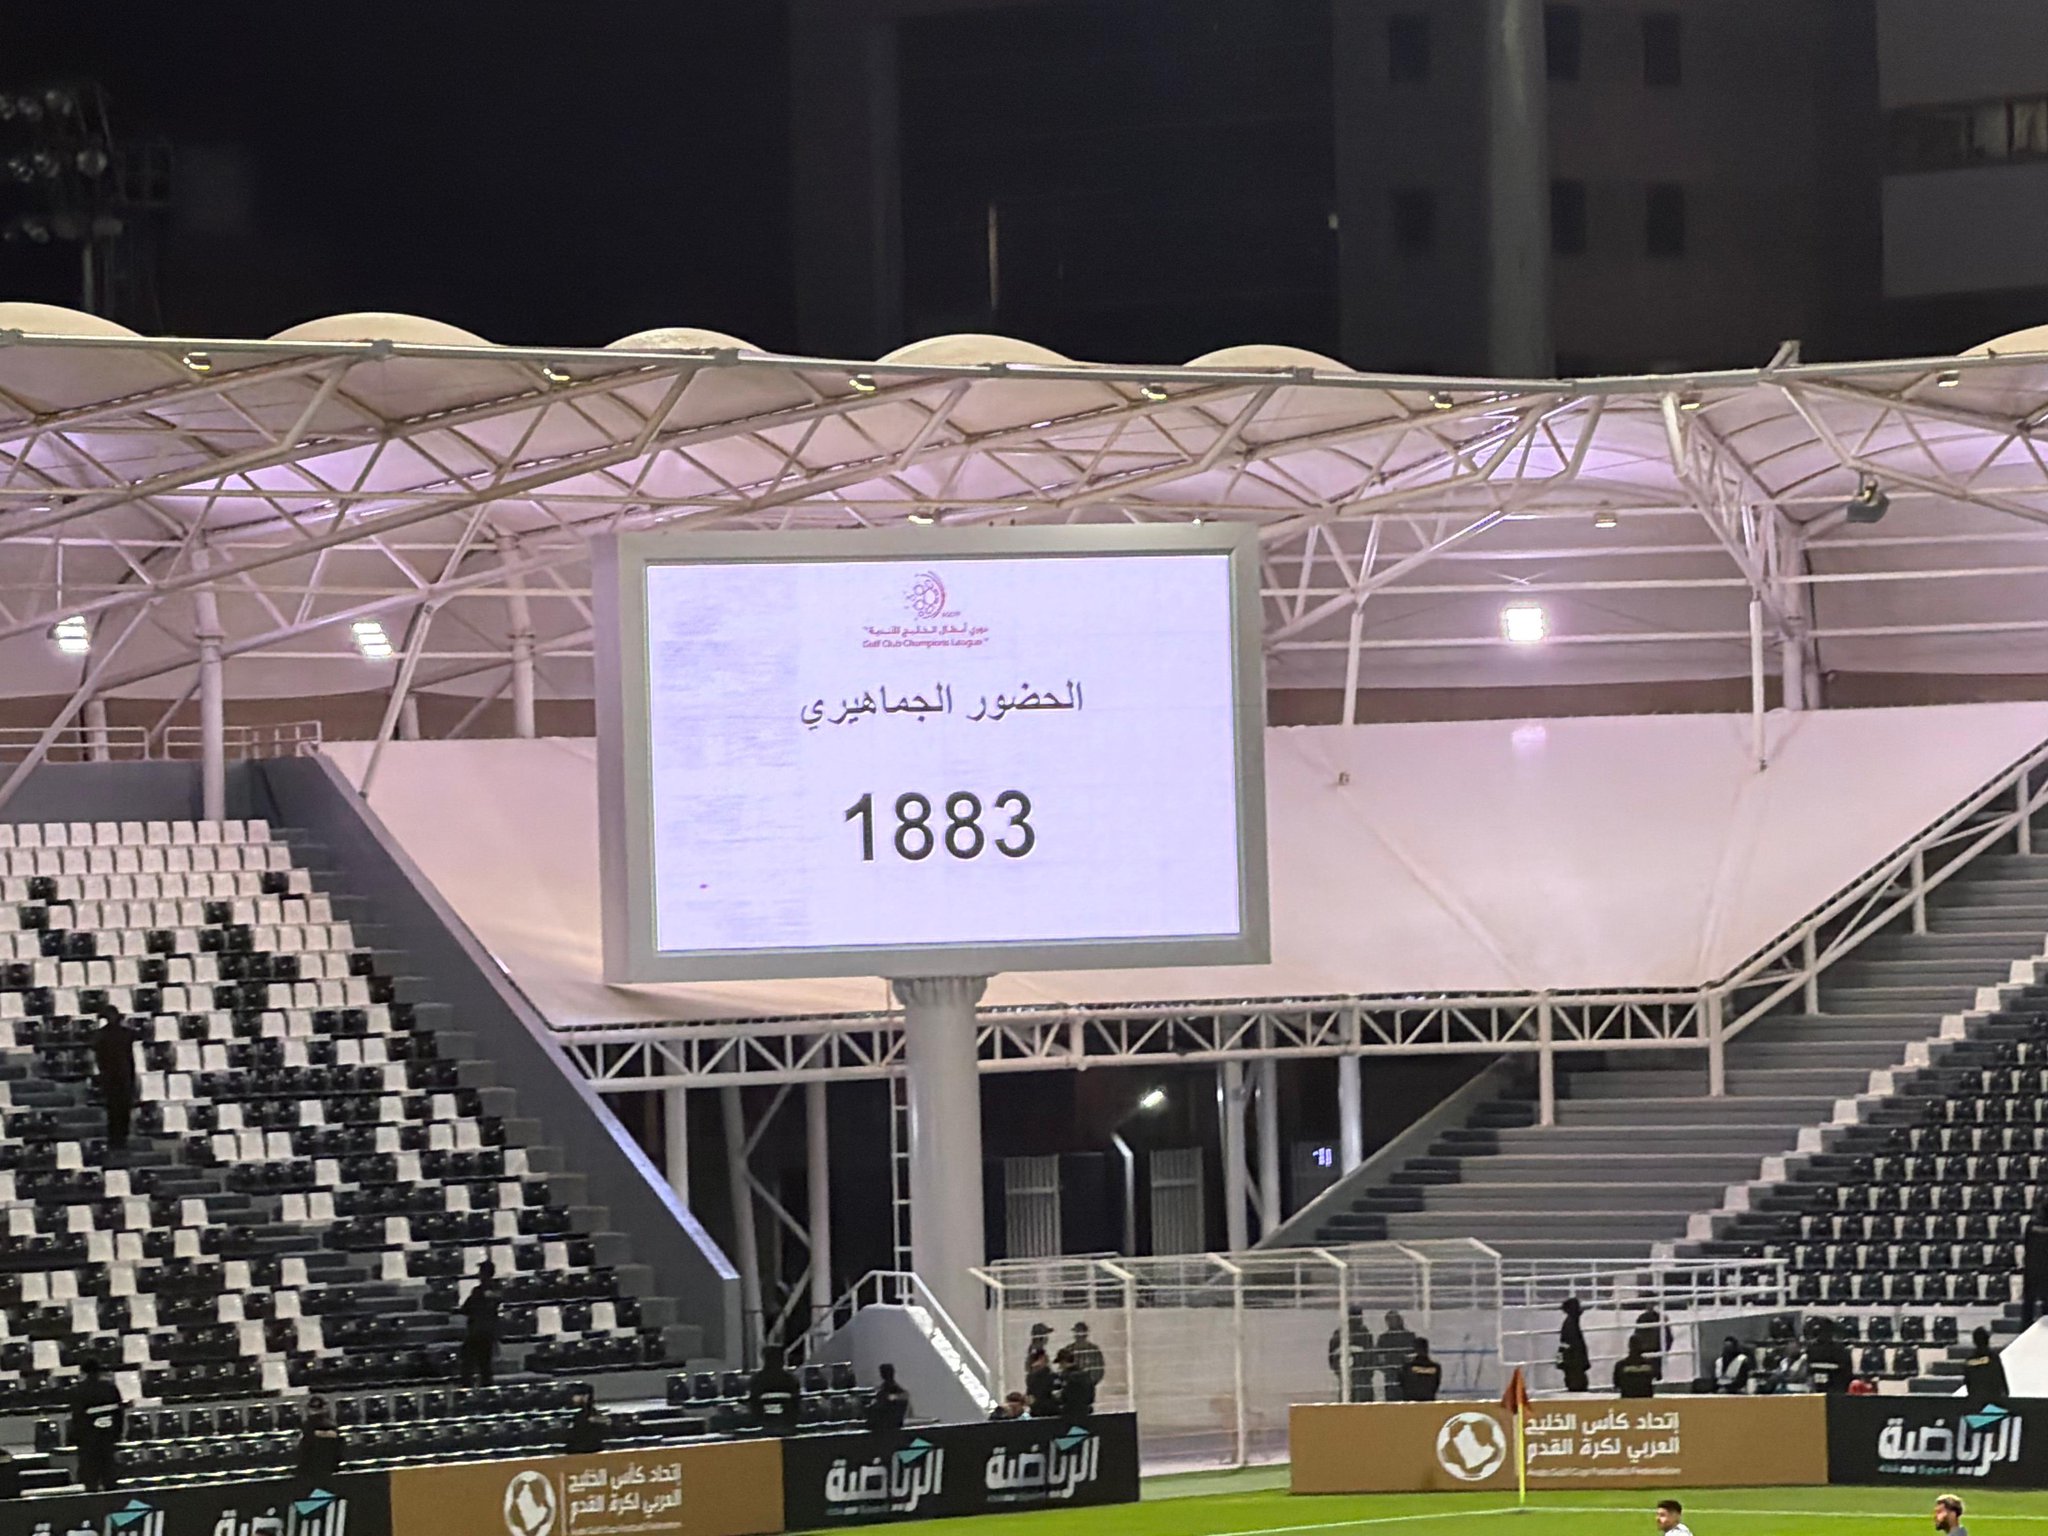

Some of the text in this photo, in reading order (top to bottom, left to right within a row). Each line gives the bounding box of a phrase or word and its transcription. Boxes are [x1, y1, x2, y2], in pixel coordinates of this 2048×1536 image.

[800, 679, 1084, 731] الحضور الجماهيري
[843, 789, 1036, 862] 1883
[1524, 1412, 1577, 1435] الخليج
[1526, 1436, 1681, 1464] العربي لكرة القدم
[1581, 1408, 1630, 1435] كأس
[1878, 1415, 2023, 1477] الرياضية
[824, 1448, 945, 1512] الرياضية
[984, 1436, 1100, 1498] الرياضية
